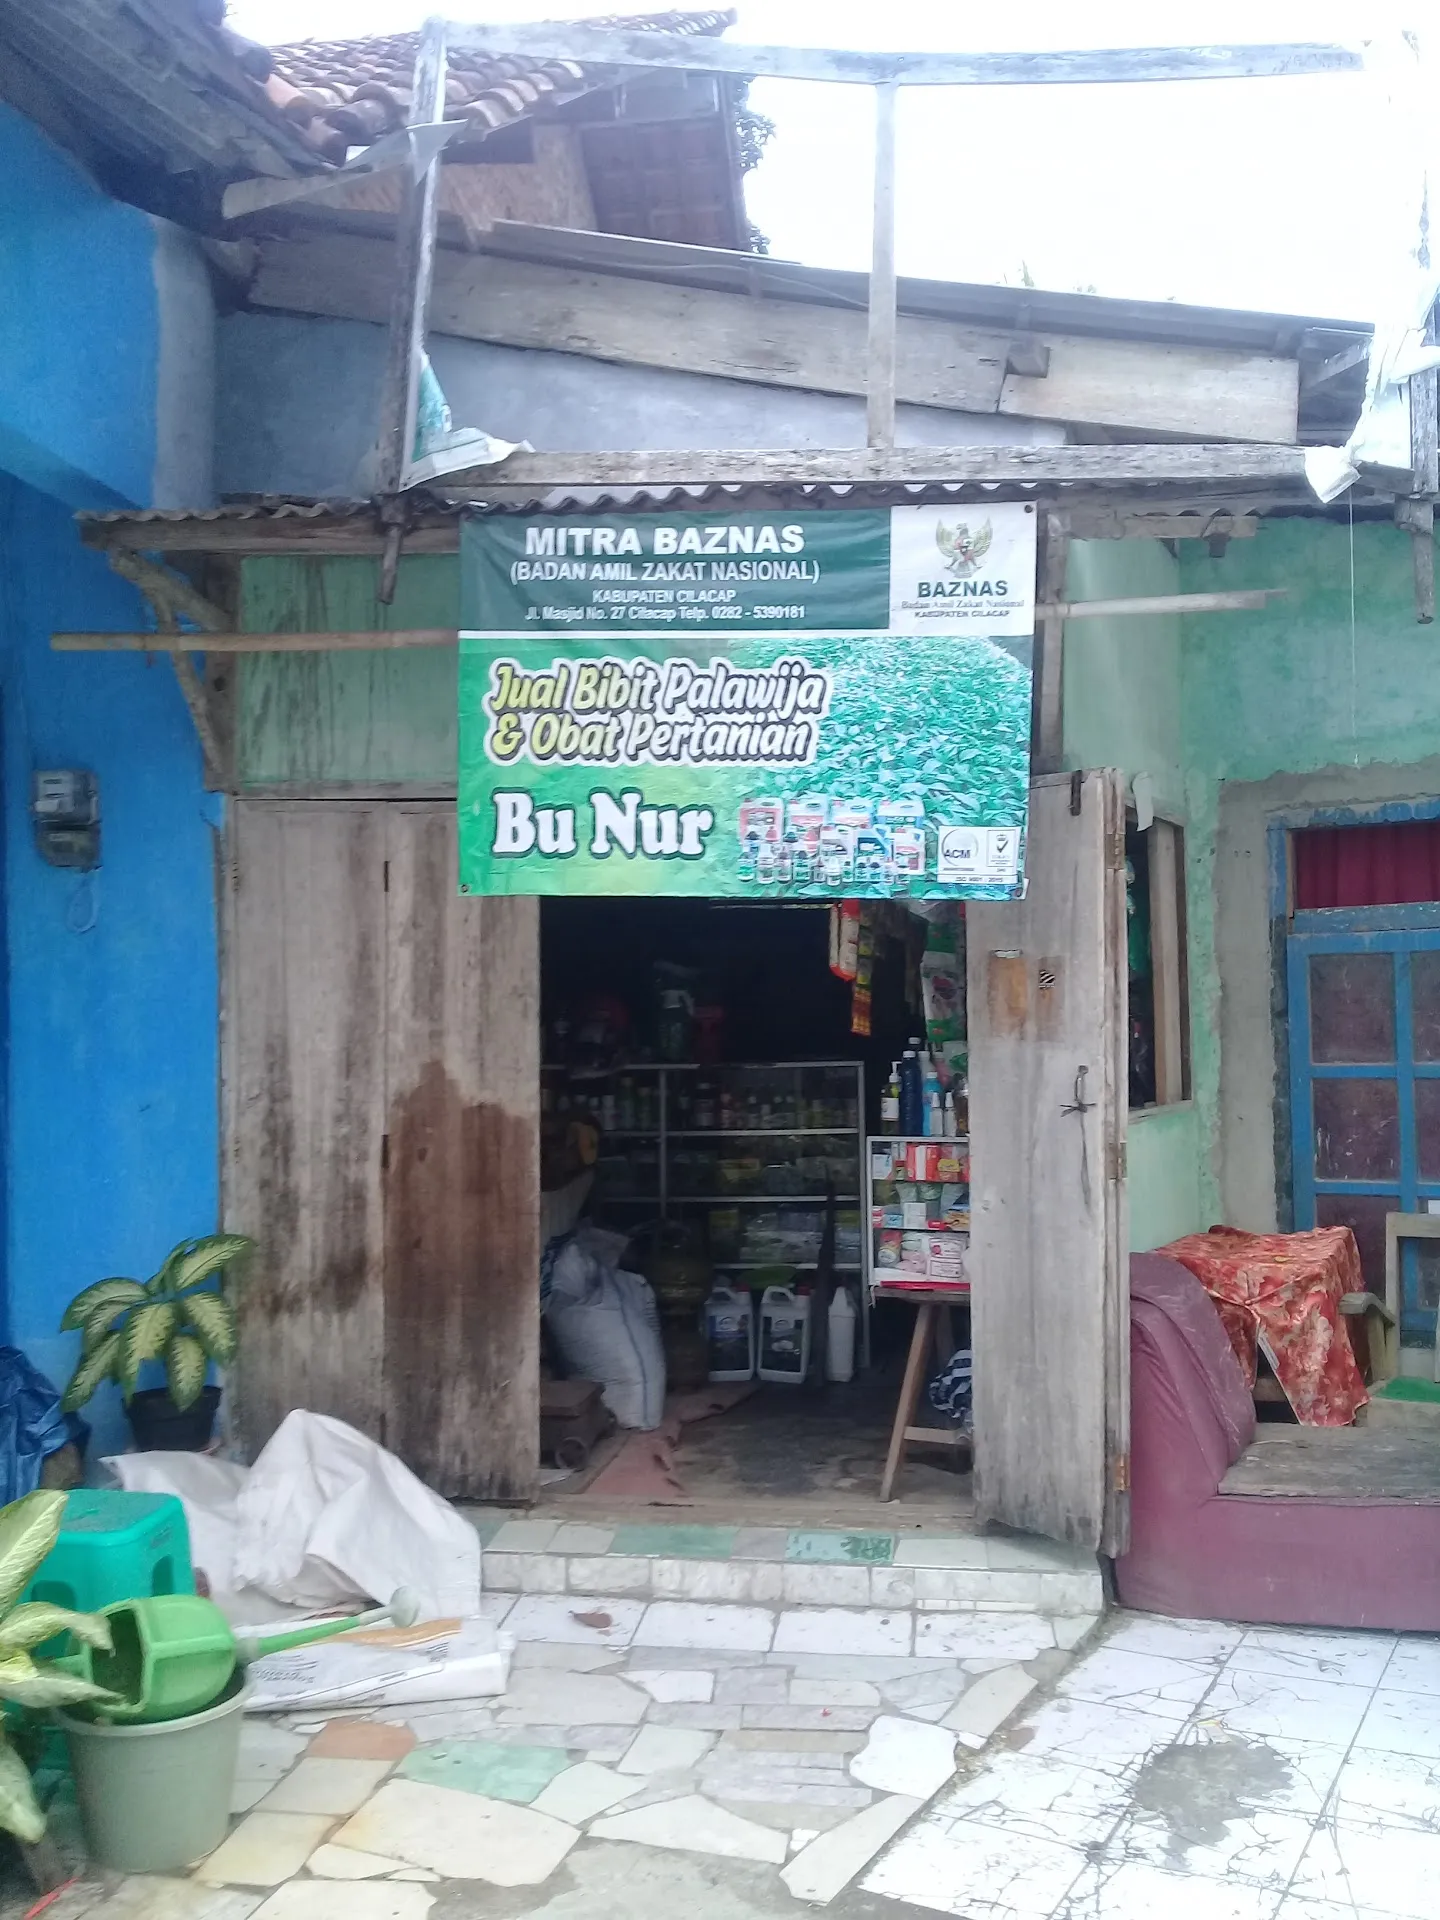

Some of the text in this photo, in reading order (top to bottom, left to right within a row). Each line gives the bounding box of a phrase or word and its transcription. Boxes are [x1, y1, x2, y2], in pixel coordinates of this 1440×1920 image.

[525, 524, 805, 556] MITRA BAZNAS
[510, 559, 820, 585] (BADAN AMIL ZAKAT NASIONAL)
[592, 589, 737, 603] KABUPATEN CILACAP
[917, 580, 1008, 598] BAZNAS
[542, 605, 585, 623] Masjid
[586, 606, 608, 620] No.
[609, 606, 626, 620] 27
[628, 605, 677, 623] Cilacap
[678, 605, 709, 623] Telp.
[711, 605, 743, 619] 0282
[752, 604, 805, 619] 5390181
[492, 660, 827, 720] Jual Bibit Palawija
[491, 712, 812, 762] & Obat Pertanian
[491, 787, 715, 860] Bu Nur
